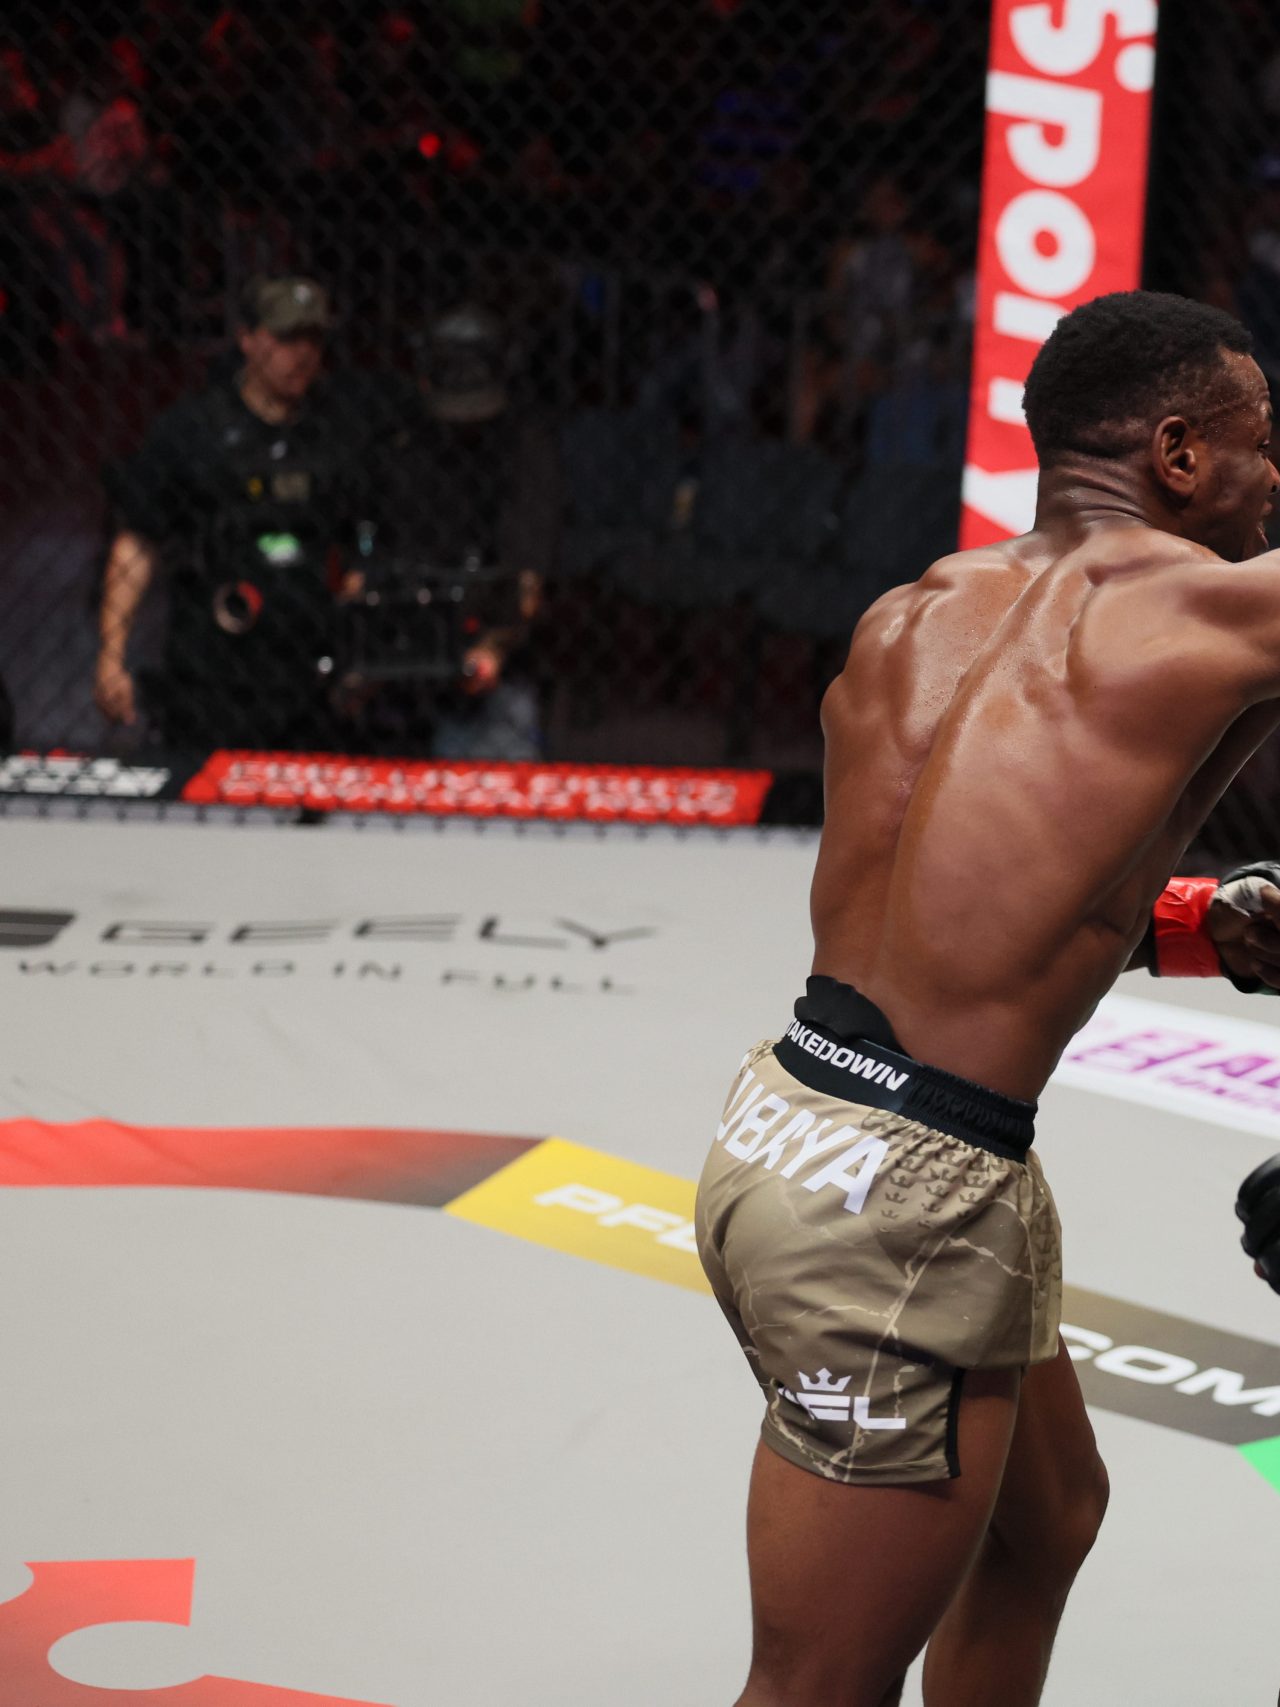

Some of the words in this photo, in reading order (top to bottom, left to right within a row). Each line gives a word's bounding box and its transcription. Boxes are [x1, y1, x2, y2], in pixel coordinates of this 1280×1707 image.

[961, 0, 1157, 536] Spoy
[18, 960, 294, 978] WORLD
[333, 960, 401, 978] IN
[442, 969, 635, 993] FULL
[101, 913, 656, 950] GEELY
[716, 1052, 890, 1215] UBAYA
